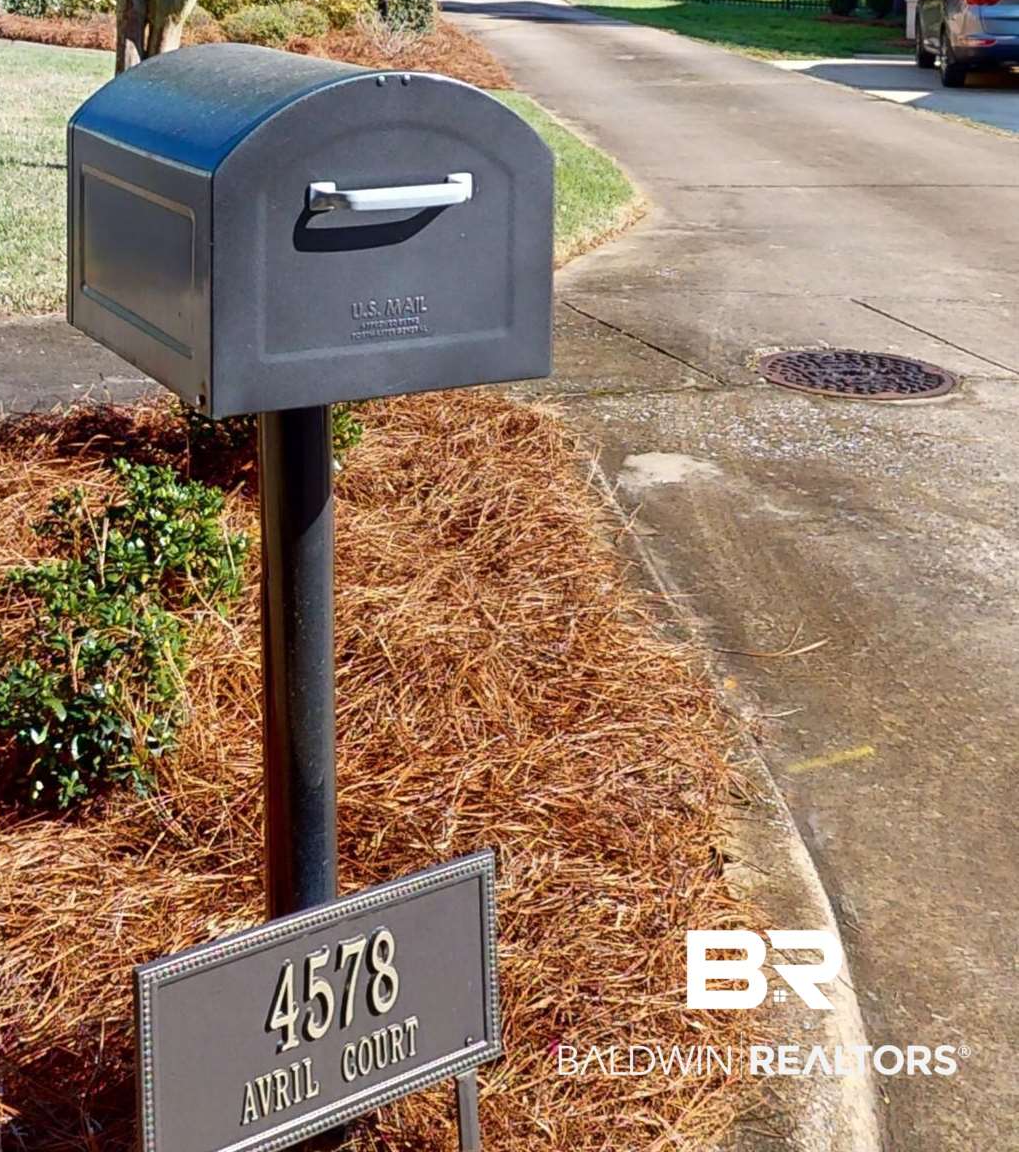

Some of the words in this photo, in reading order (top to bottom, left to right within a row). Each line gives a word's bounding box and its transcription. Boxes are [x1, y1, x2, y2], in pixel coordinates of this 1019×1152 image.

[351, 299, 381, 320] U.S.
[384, 295, 427, 316] MAIL
[267, 925, 399, 1052] 4578
[241, 1057, 319, 1125] AVRIL
[342, 1016, 418, 1082] COURT
